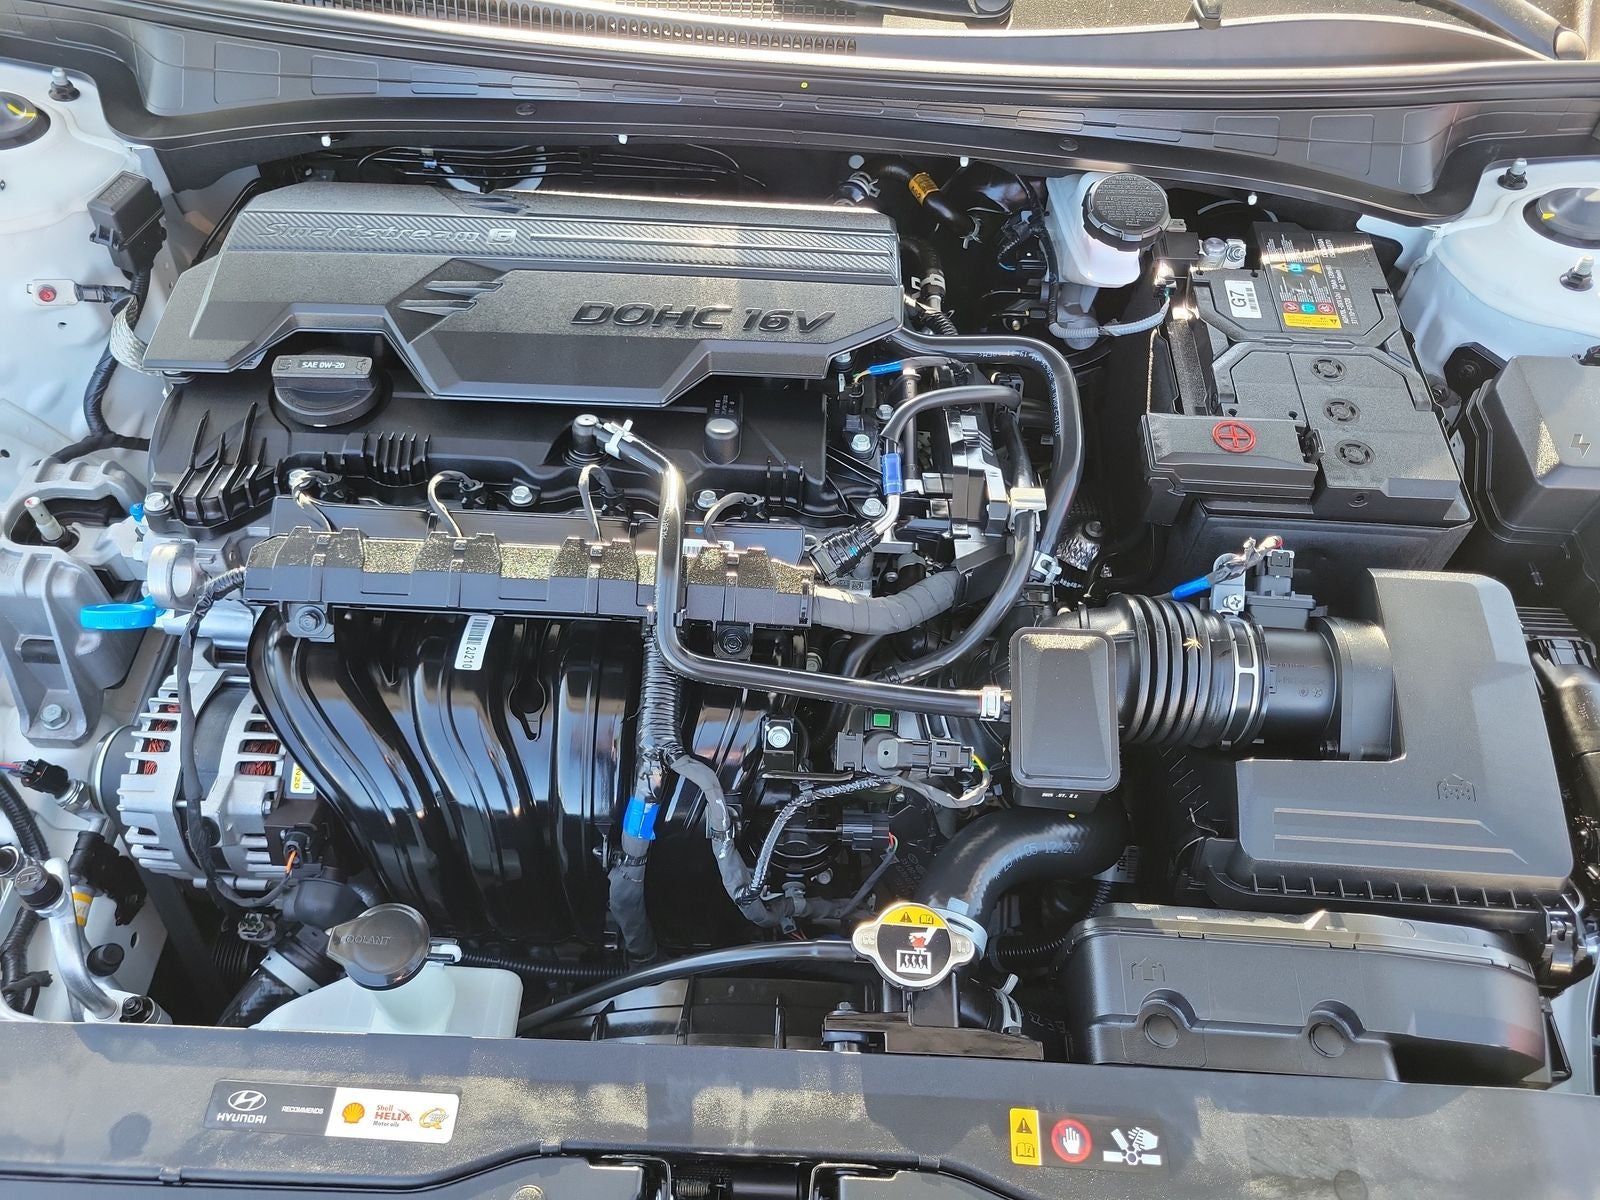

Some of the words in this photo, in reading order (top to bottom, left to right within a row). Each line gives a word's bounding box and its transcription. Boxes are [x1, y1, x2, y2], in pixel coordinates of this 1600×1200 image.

[257, 221, 480, 243] Smartstream
[490, 229, 515, 244] G
[1229, 289, 1247, 308] G7
[571, 300, 733, 330] DOHC
[742, 307, 836, 333] 16V
[301, 361, 317, 369] SAE
[319, 361, 346, 369] 0W-20
[462, 646, 477, 669] 2J210
[340, 934, 391, 946] COOLANT
[216, 1112, 267, 1124] HYUNDAI
[281, 1105, 325, 1115] RECOMMENDS
[374, 1111, 412, 1122] HELIX
[376, 1104, 395, 1112] Shell
